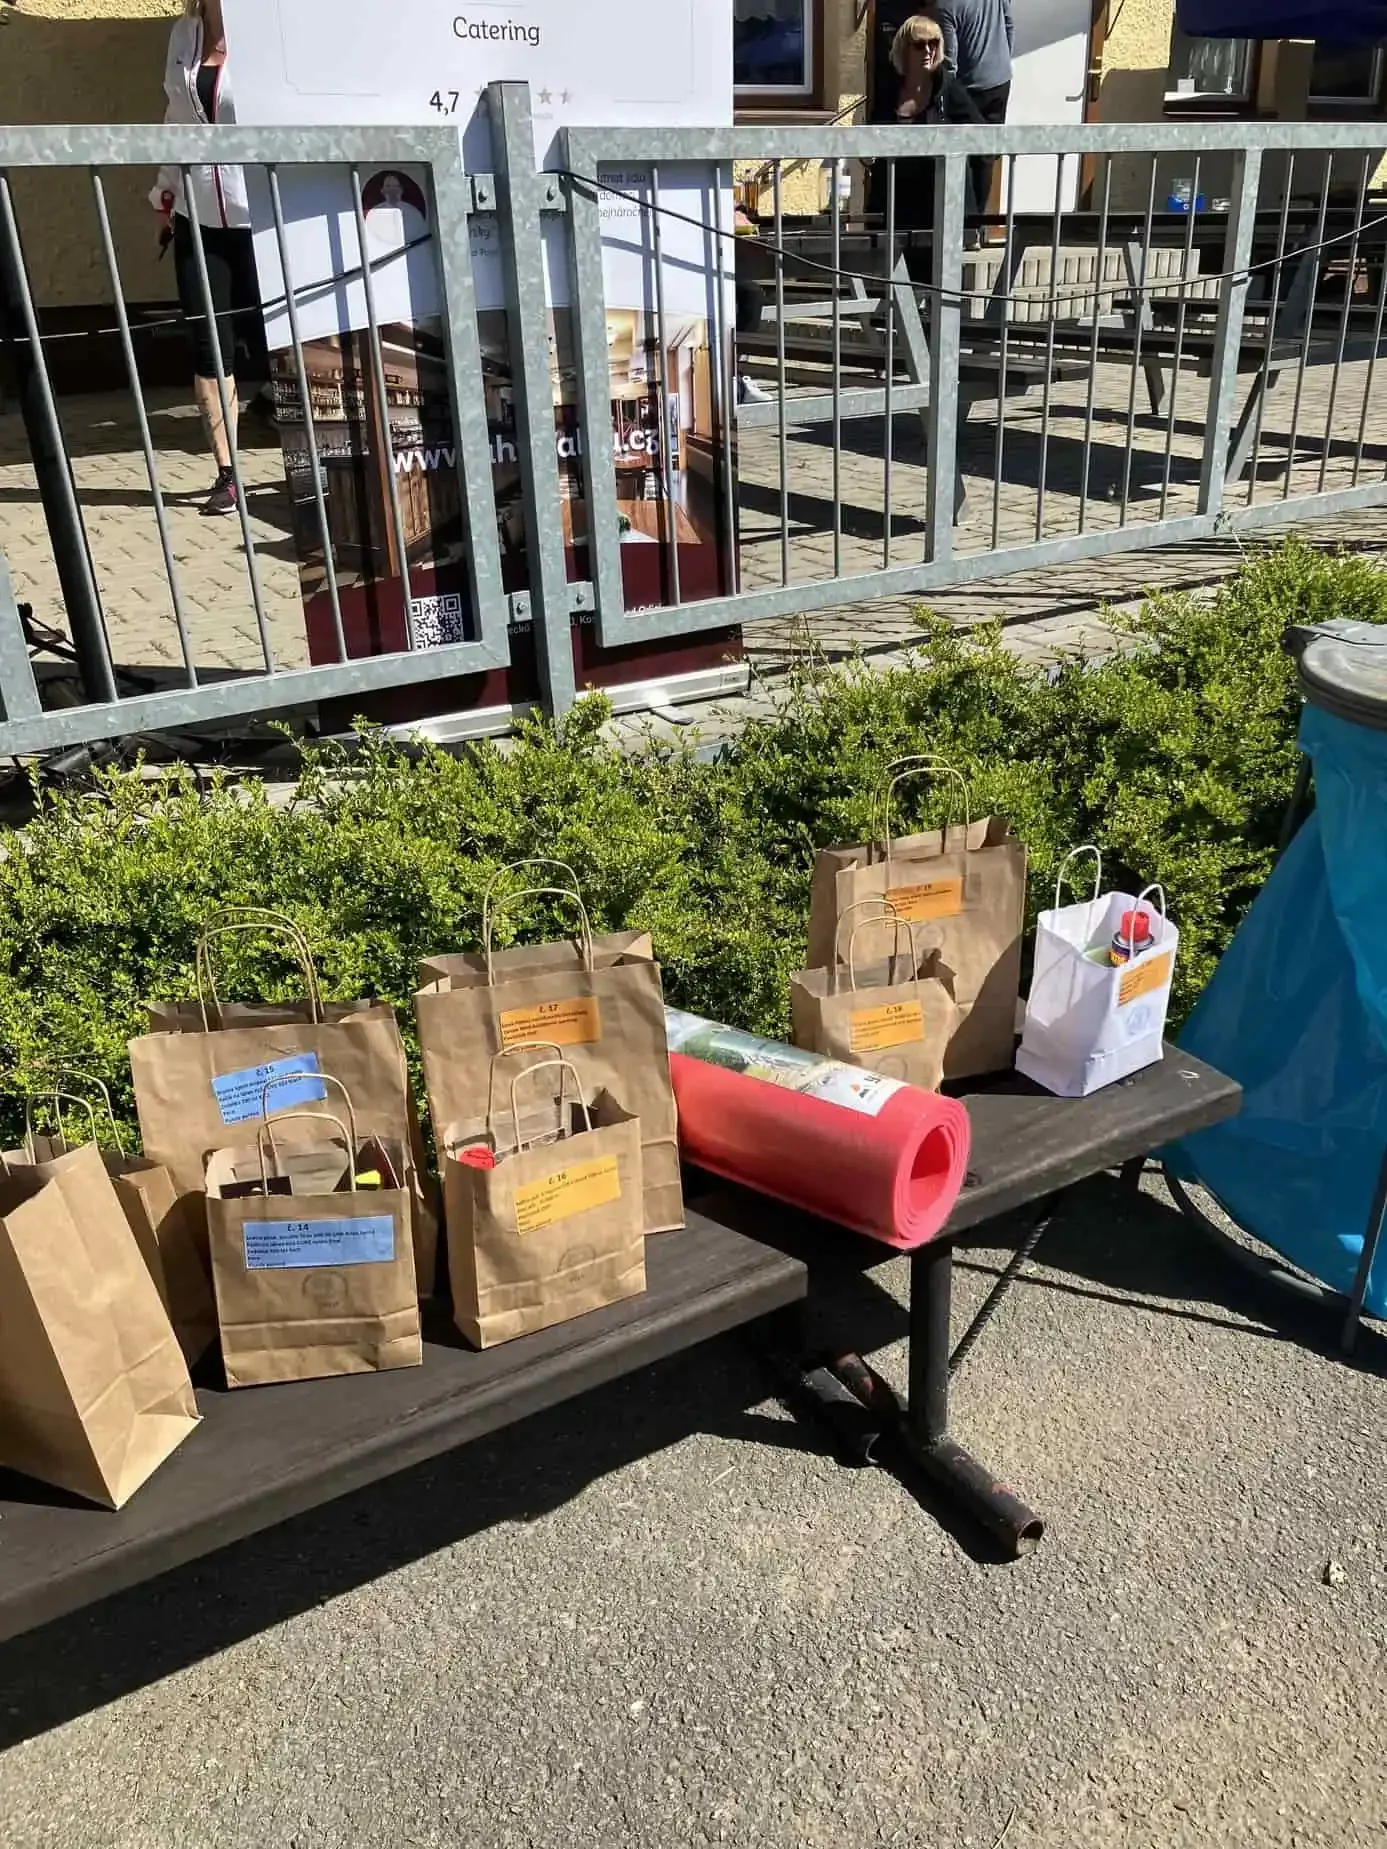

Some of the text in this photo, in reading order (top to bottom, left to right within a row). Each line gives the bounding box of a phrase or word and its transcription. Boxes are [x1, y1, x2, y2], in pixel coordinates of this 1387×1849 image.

[453, 16, 540, 46] Catering
[429, 90, 460, 116] 4,7
[297, 1223, 309, 1232] 14
